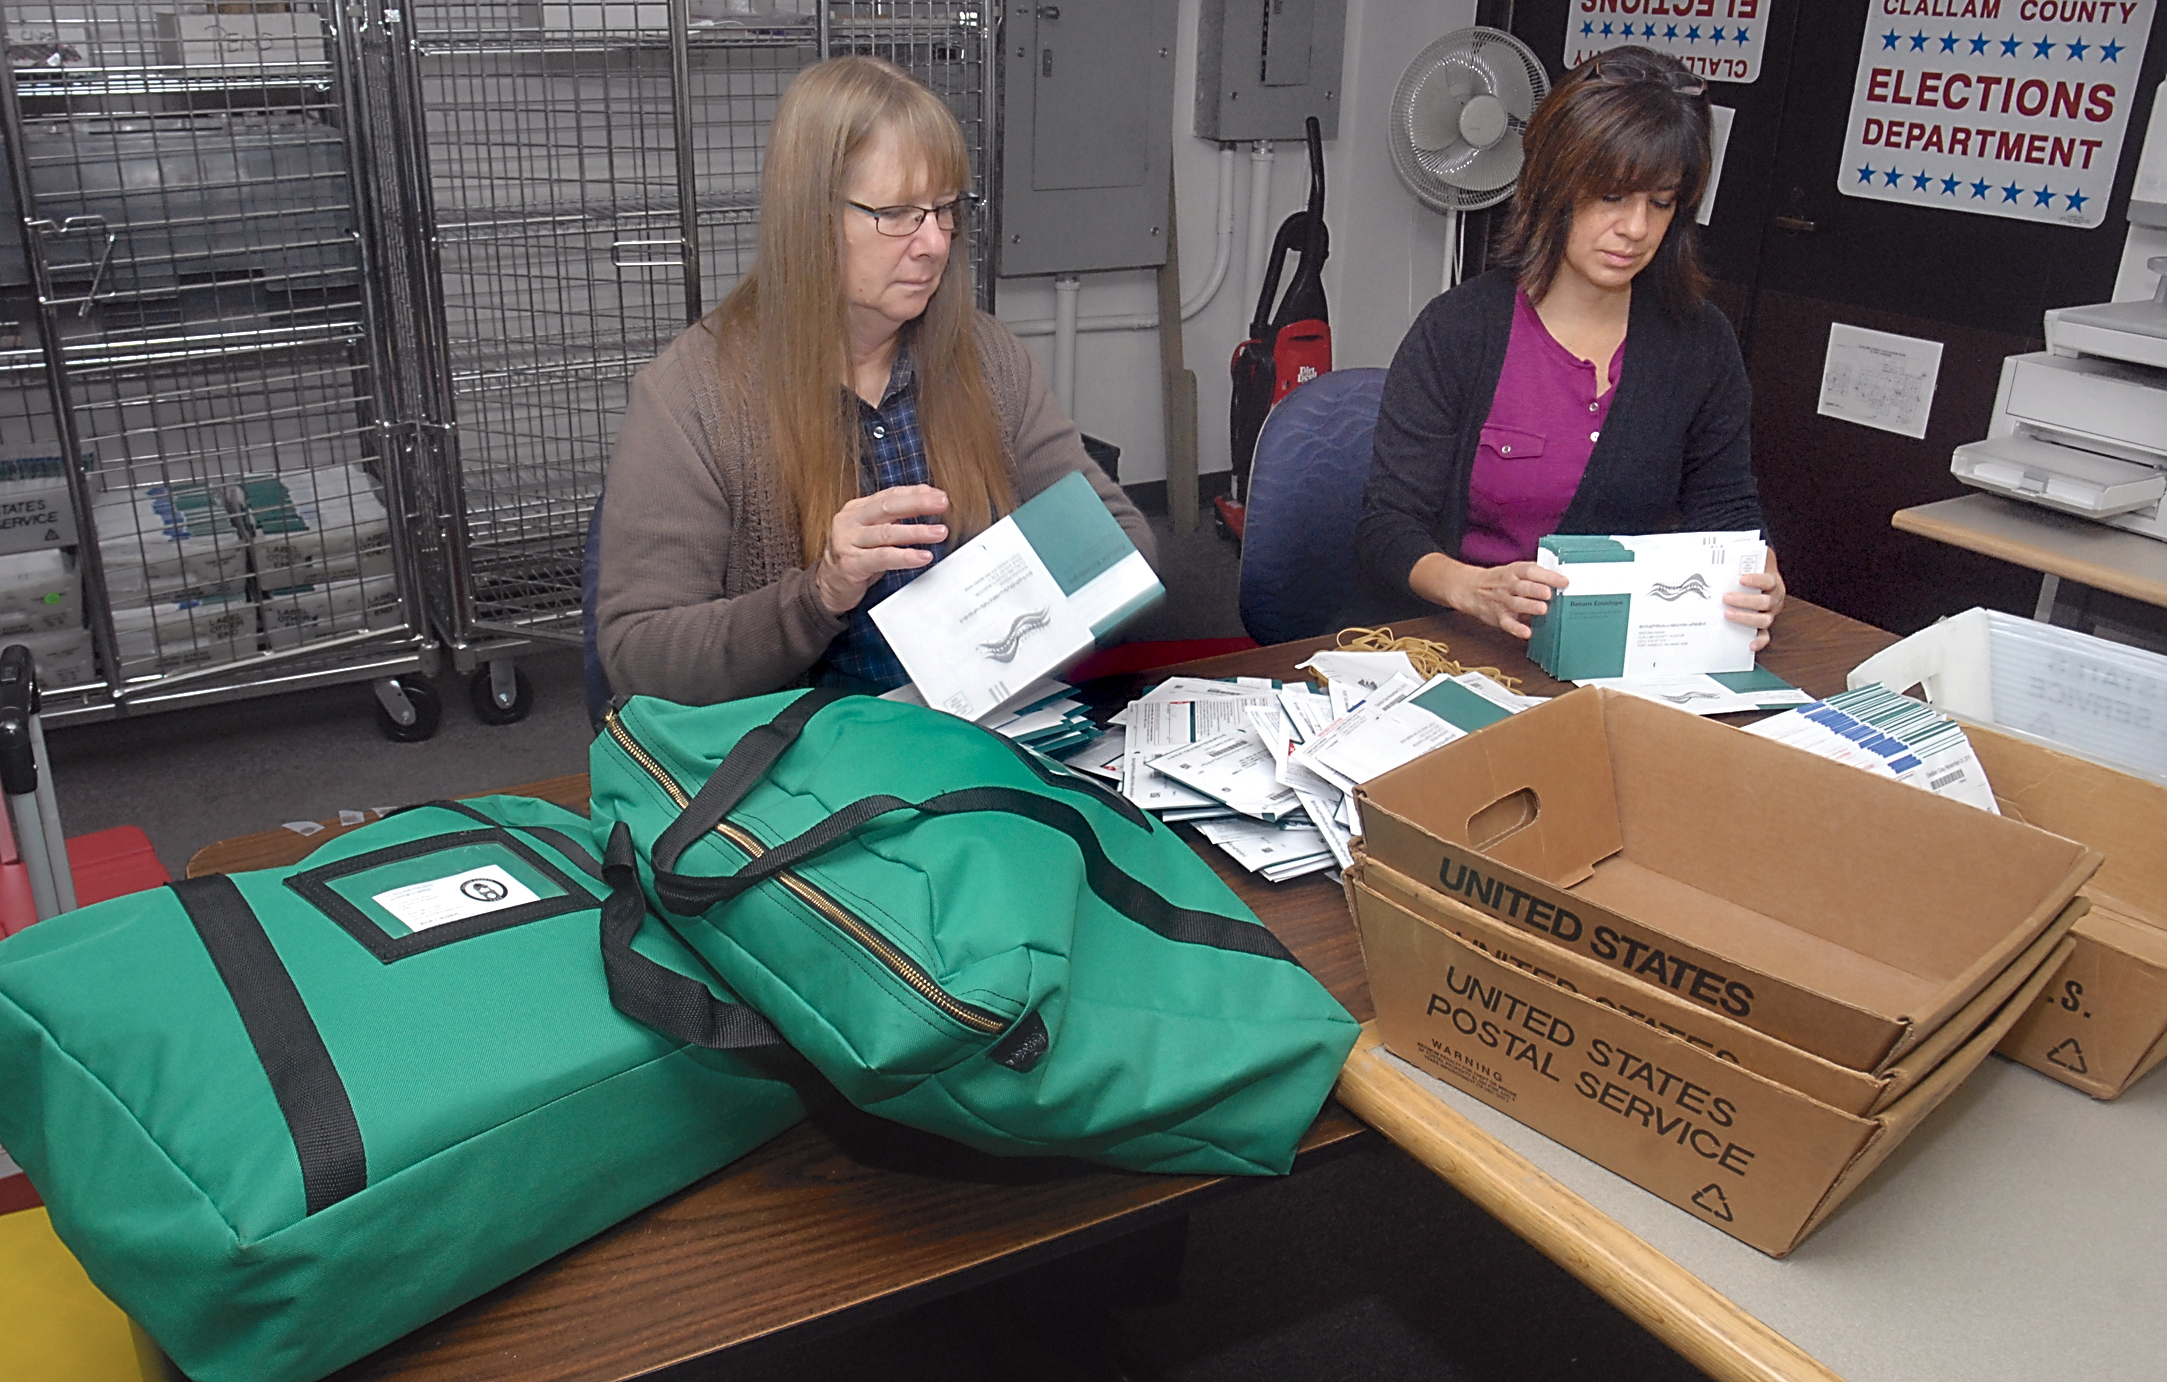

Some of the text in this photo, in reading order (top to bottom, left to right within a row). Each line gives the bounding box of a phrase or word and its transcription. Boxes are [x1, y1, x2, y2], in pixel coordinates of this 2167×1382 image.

[1883, 0, 2138, 24] CLALLAM COUNTY
[1680, 56, 1748, 78] CLALL
[1866, 68, 2117, 122] ELECTIONS
[1862, 118, 2103, 169] DEPARTMENT
[0, 511, 58, 530] ERVICE
[2, 499, 46, 515] TATES
[1439, 857, 1583, 942] UNITED
[1590, 925, 1755, 1018] STATES
[1431, 1038, 1503, 1082] WARNING
[1446, 966, 1575, 1048] UNITED
[1587, 1038, 1737, 1127] STATES
[1426, 994, 1560, 1083] POSTAL
[1574, 1071, 1755, 1177] SERVICE
